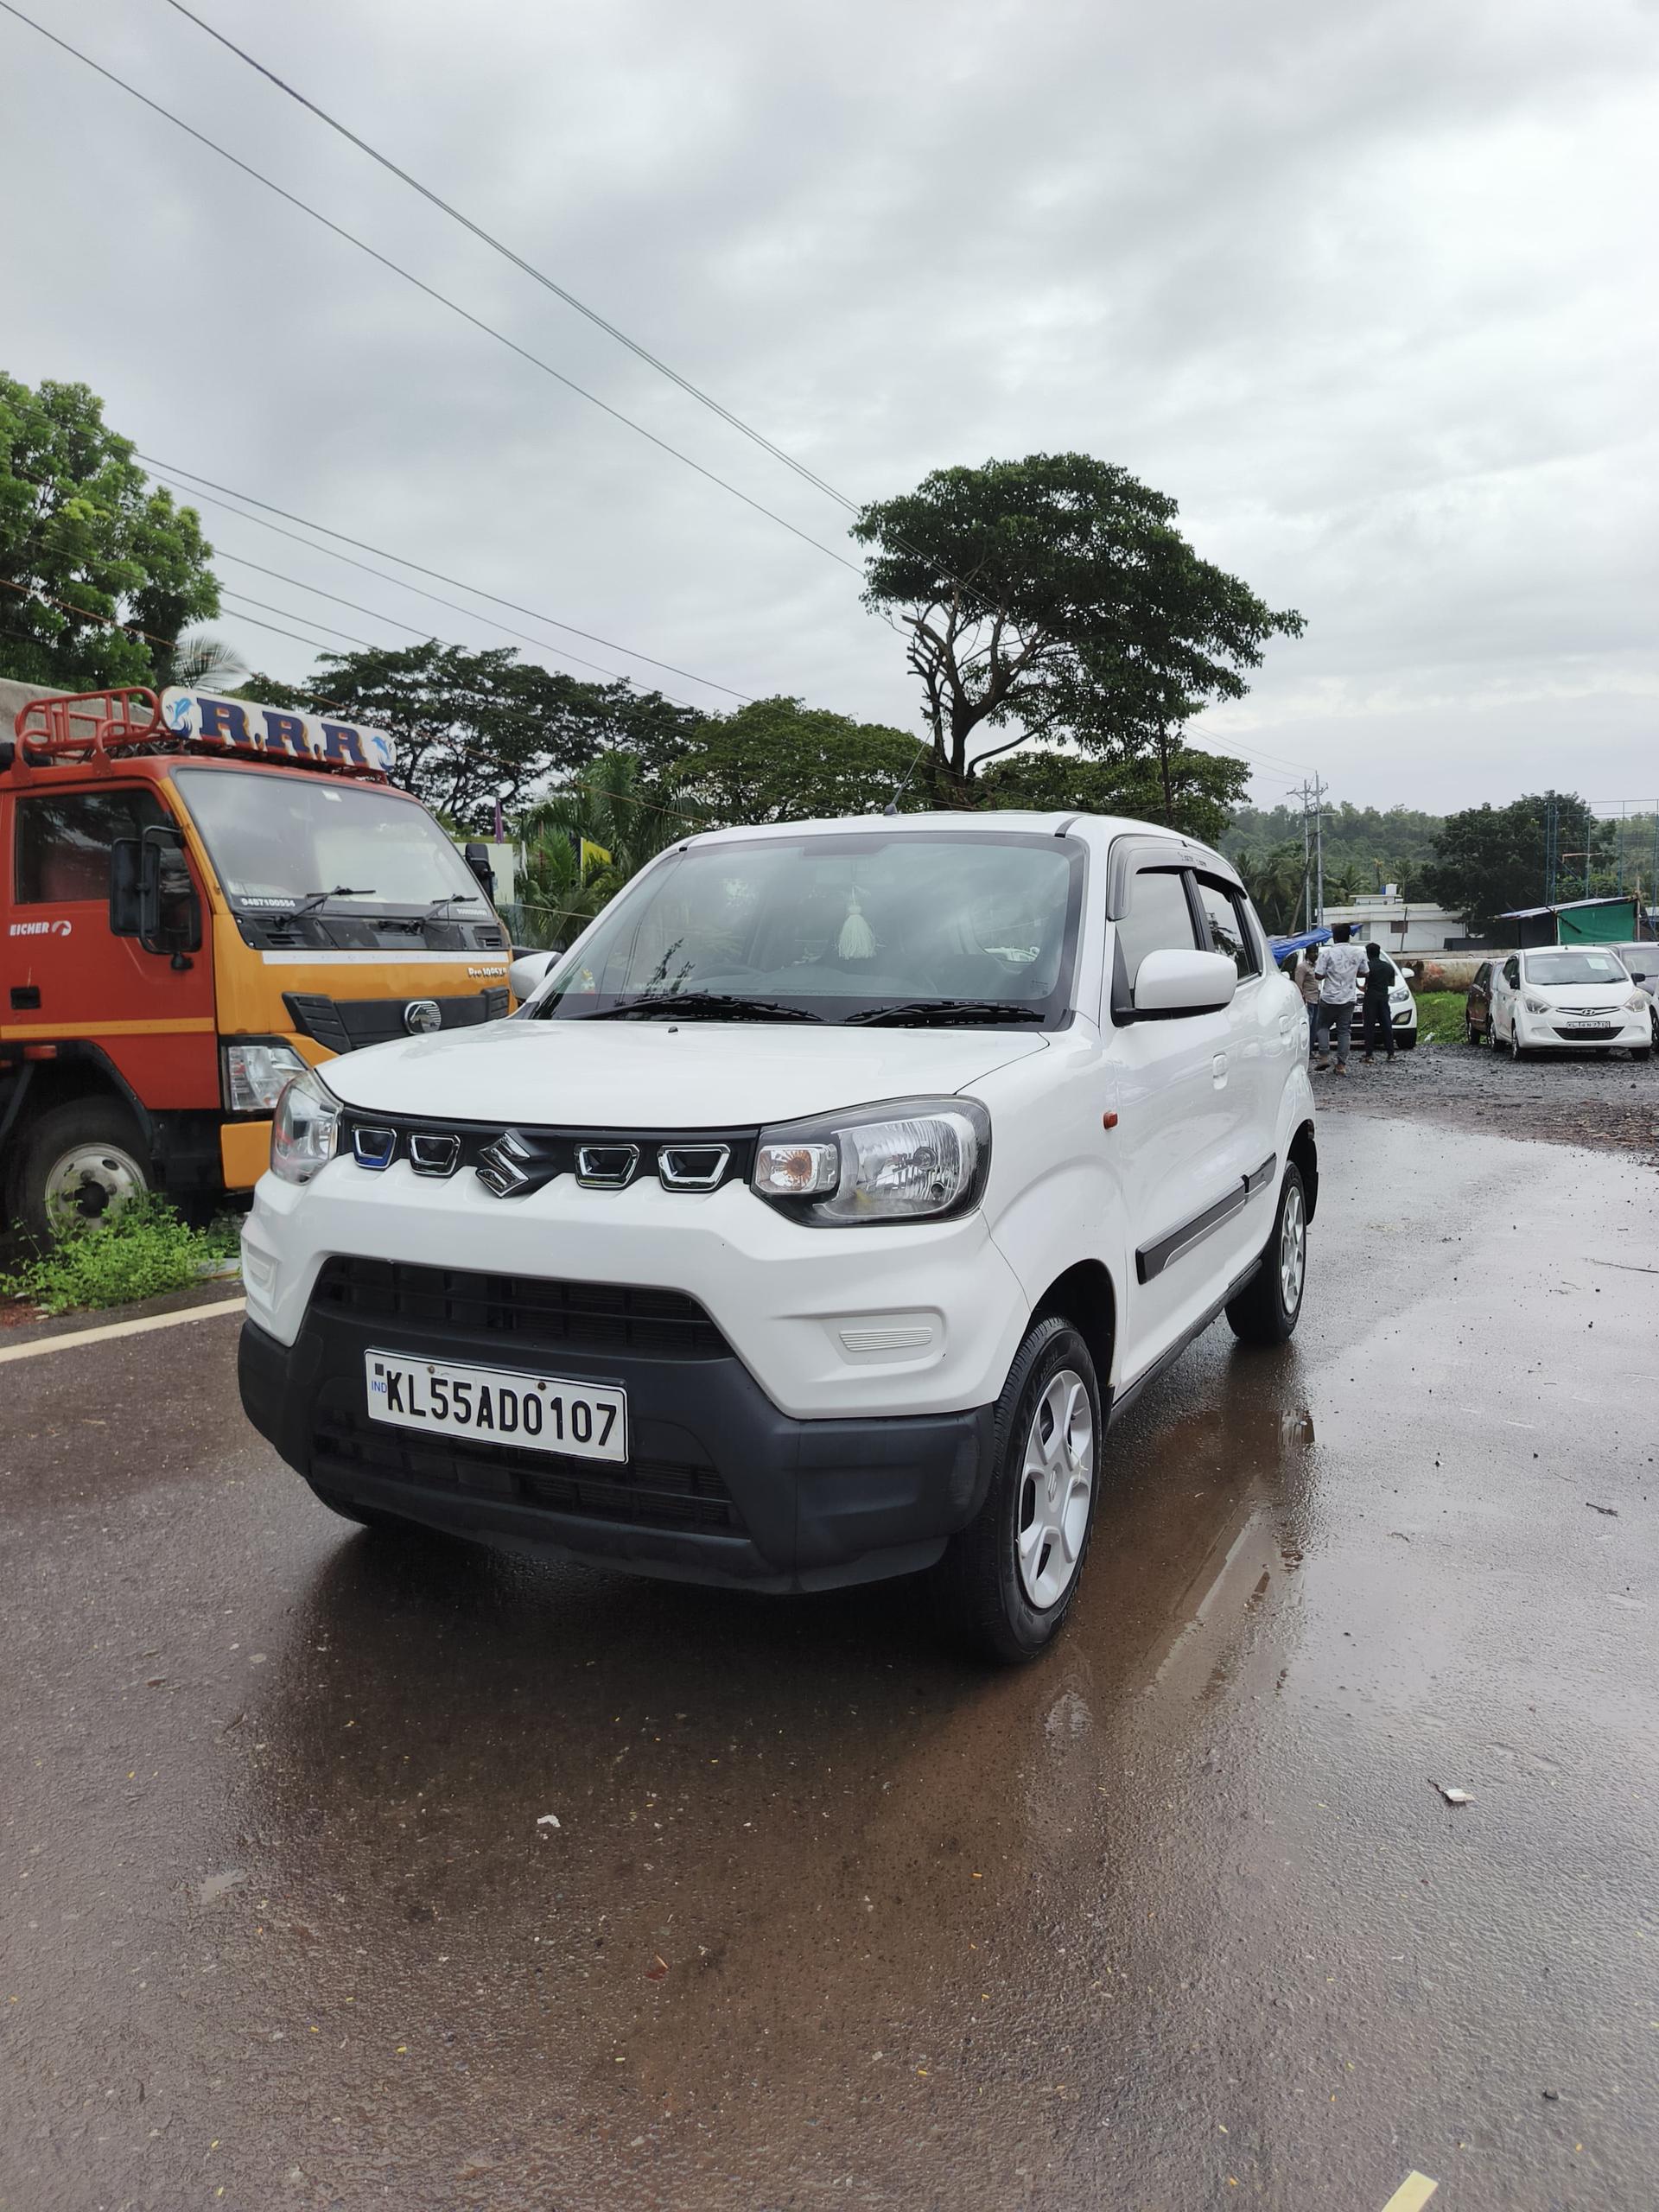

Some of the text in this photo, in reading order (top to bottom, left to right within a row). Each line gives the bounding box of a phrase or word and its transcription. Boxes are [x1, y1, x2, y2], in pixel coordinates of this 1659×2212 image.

[196, 697, 369, 766] R.R.R
[10, 921, 50, 937] EICHER
[372, 1380, 387, 1394] IND
[386, 1370, 617, 1446] KL55AD0107
